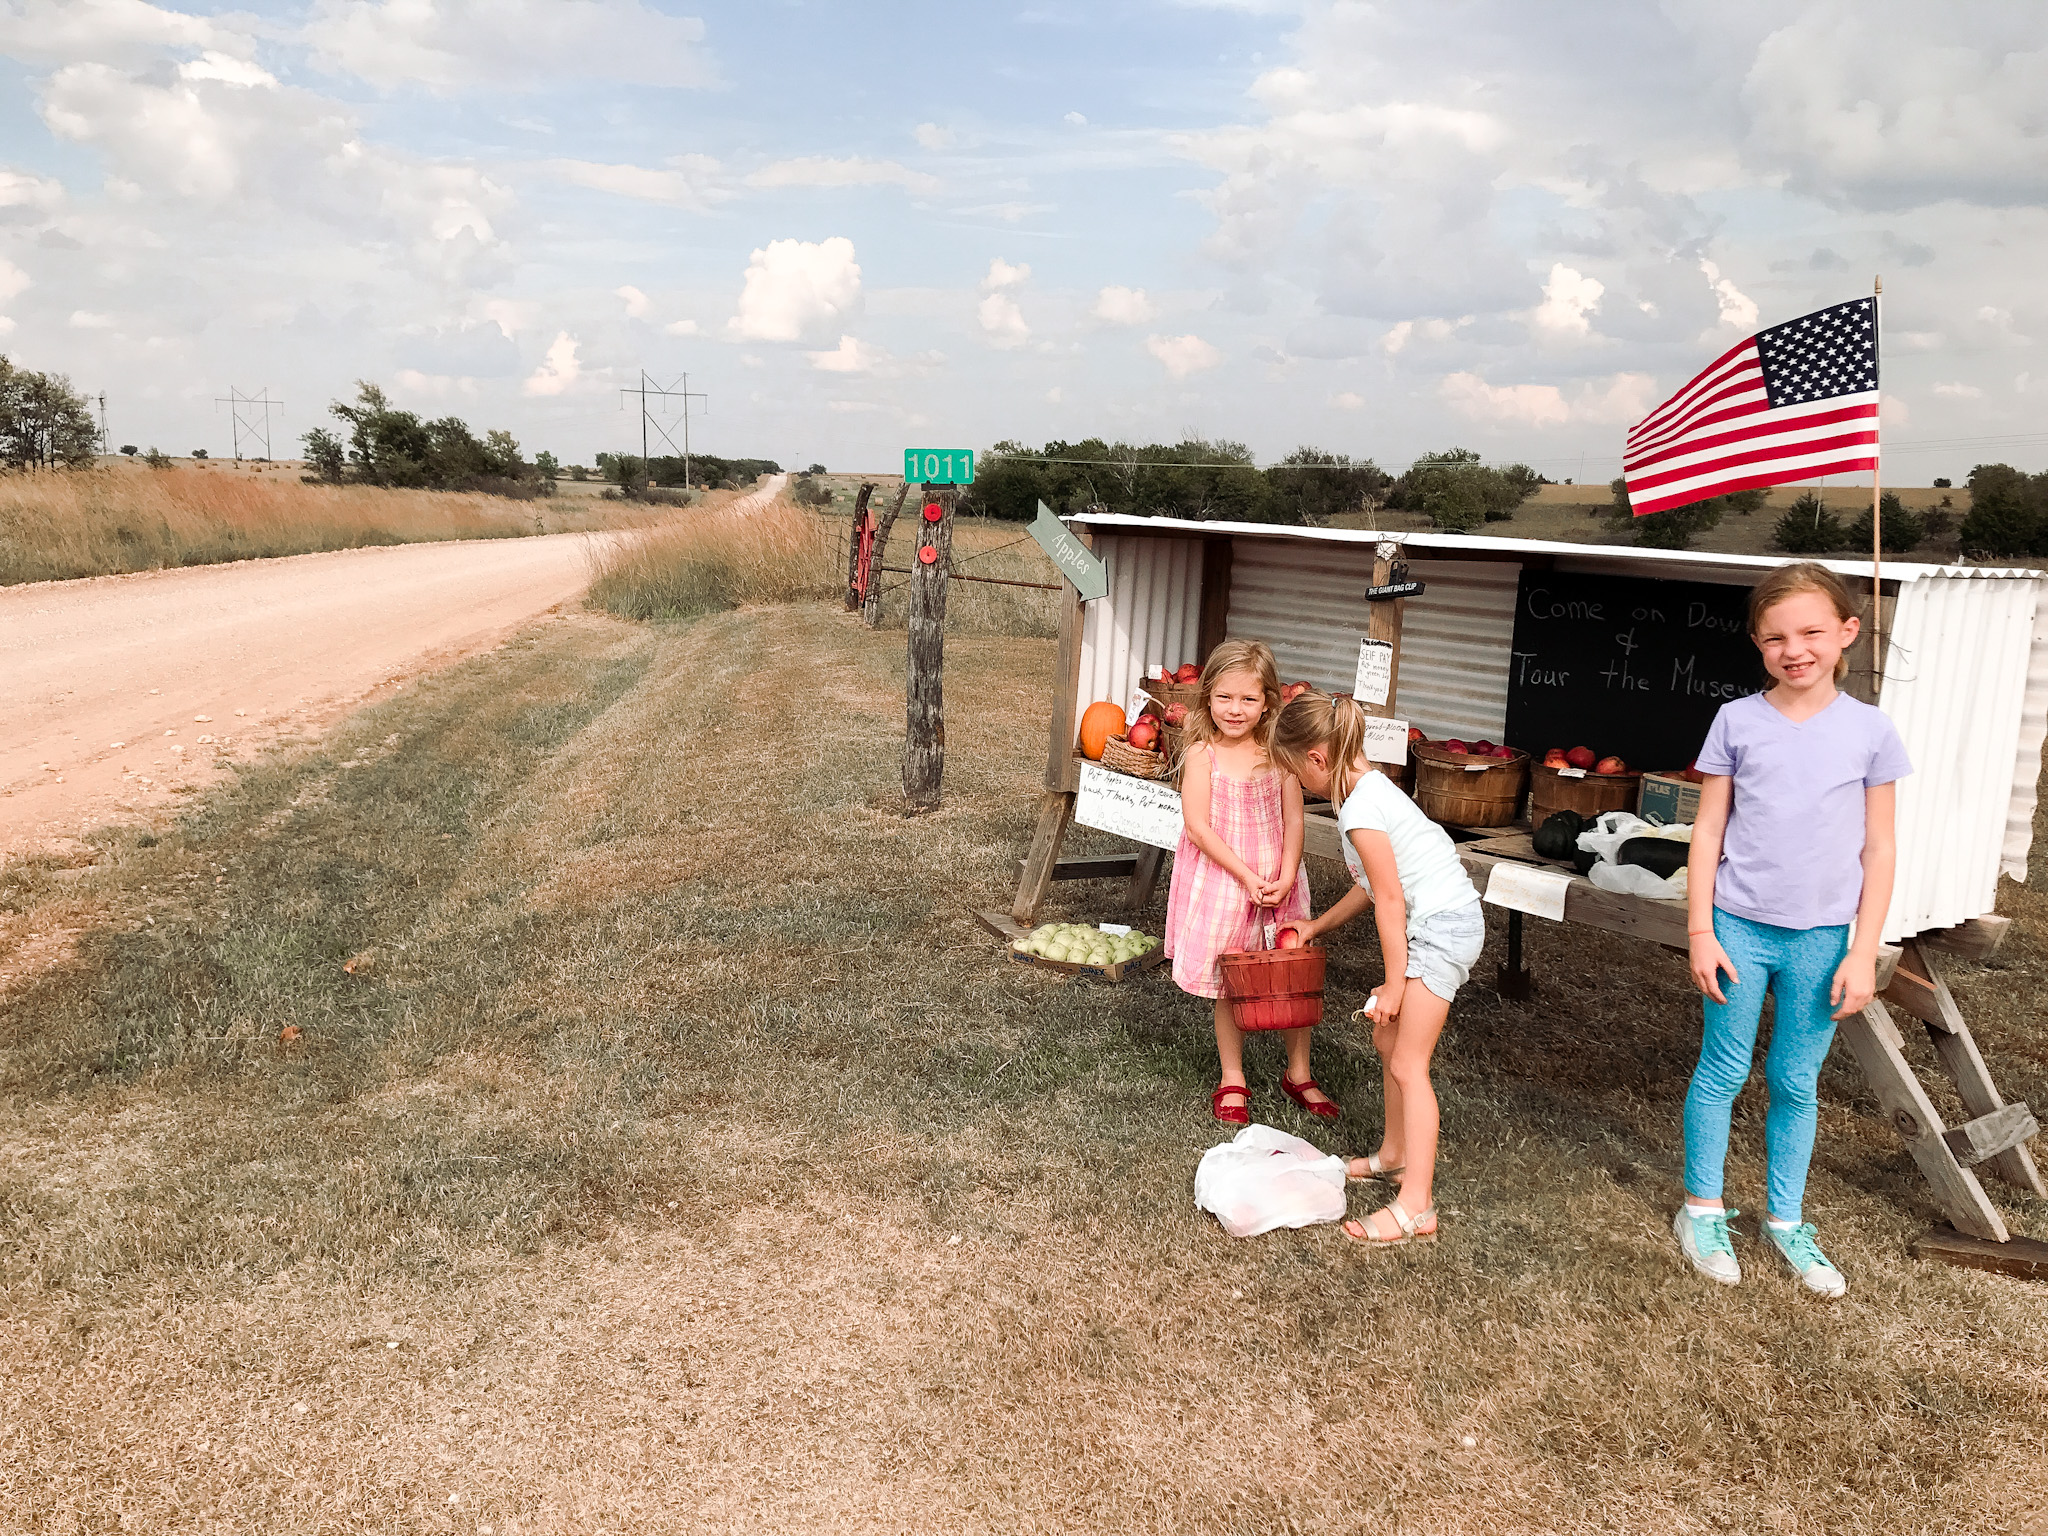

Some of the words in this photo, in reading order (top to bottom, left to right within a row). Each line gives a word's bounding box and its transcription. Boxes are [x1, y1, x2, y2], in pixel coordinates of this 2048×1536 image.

[908, 453, 970, 480] 1011
[1051, 533, 1090, 576] Apples
[1368, 587, 1378, 596] THE
[1378, 585, 1394, 595] GIANT
[1393, 584, 1404, 593] BAG
[1404, 582, 1417, 591] CLIP
[1528, 588, 1606, 620] Come
[1632, 608, 1666, 623] on
[1512, 651, 1570, 686] Tour
[1600, 659, 1650, 691] the
[1671, 654, 1762, 699] Museu
[1087, 767, 1103, 781] Put
[1125, 778, 1134, 788] in
[1138, 795, 1157, 809] Put
